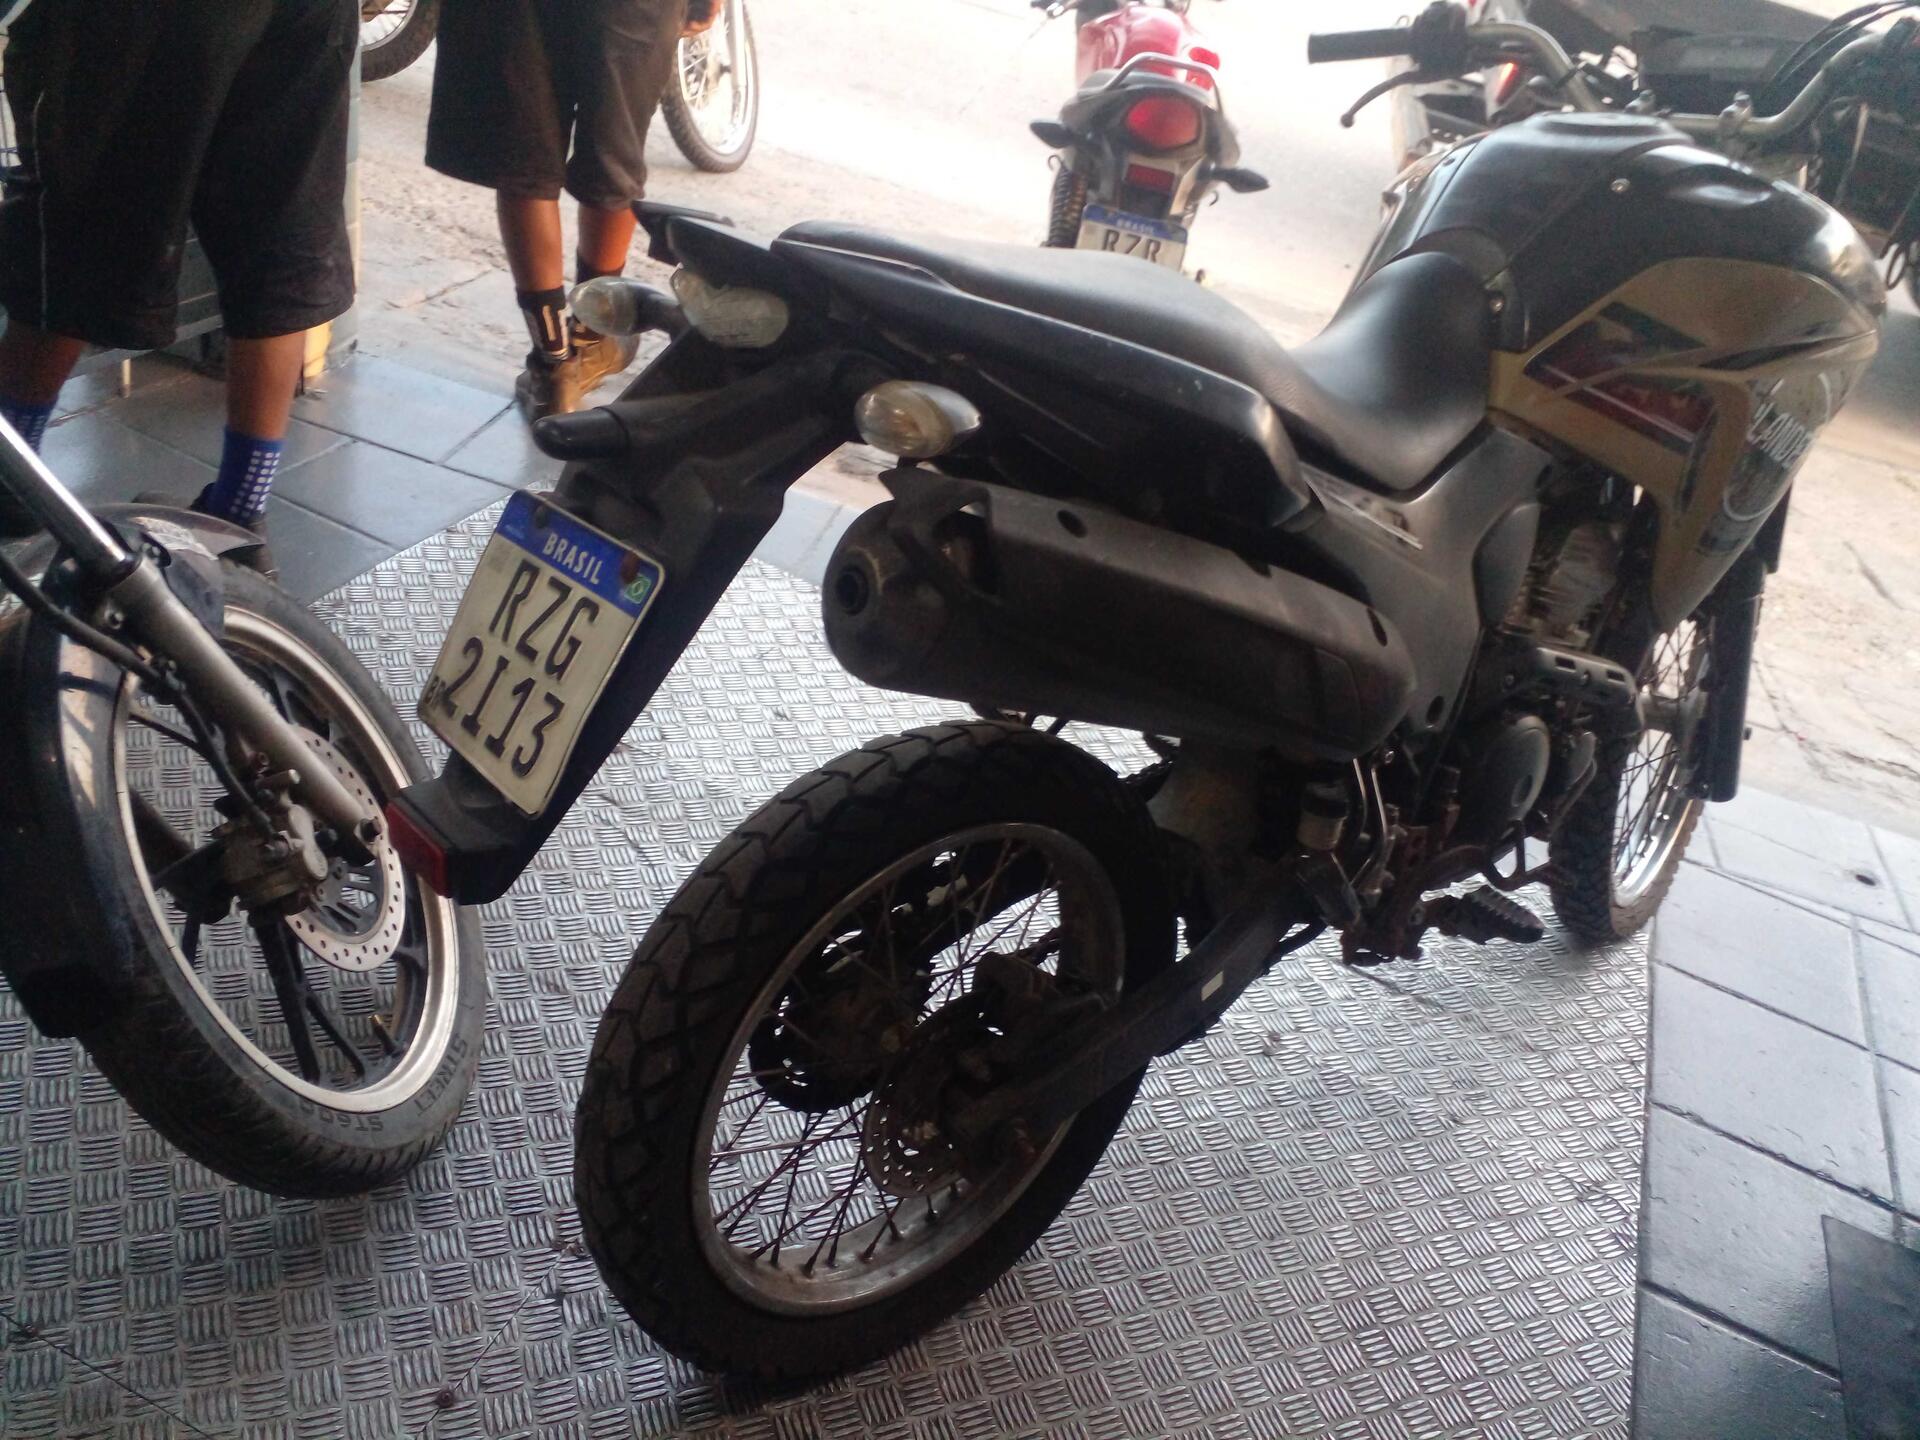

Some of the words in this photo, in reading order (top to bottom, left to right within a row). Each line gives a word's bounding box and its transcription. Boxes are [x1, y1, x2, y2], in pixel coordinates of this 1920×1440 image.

[1102, 229, 1162, 264] RZR
[1746, 402, 1815, 470] LANDE
[542, 532, 604, 585] BRASIL
[488, 557, 600, 685] RZG
[444, 636, 565, 778] 2I13
